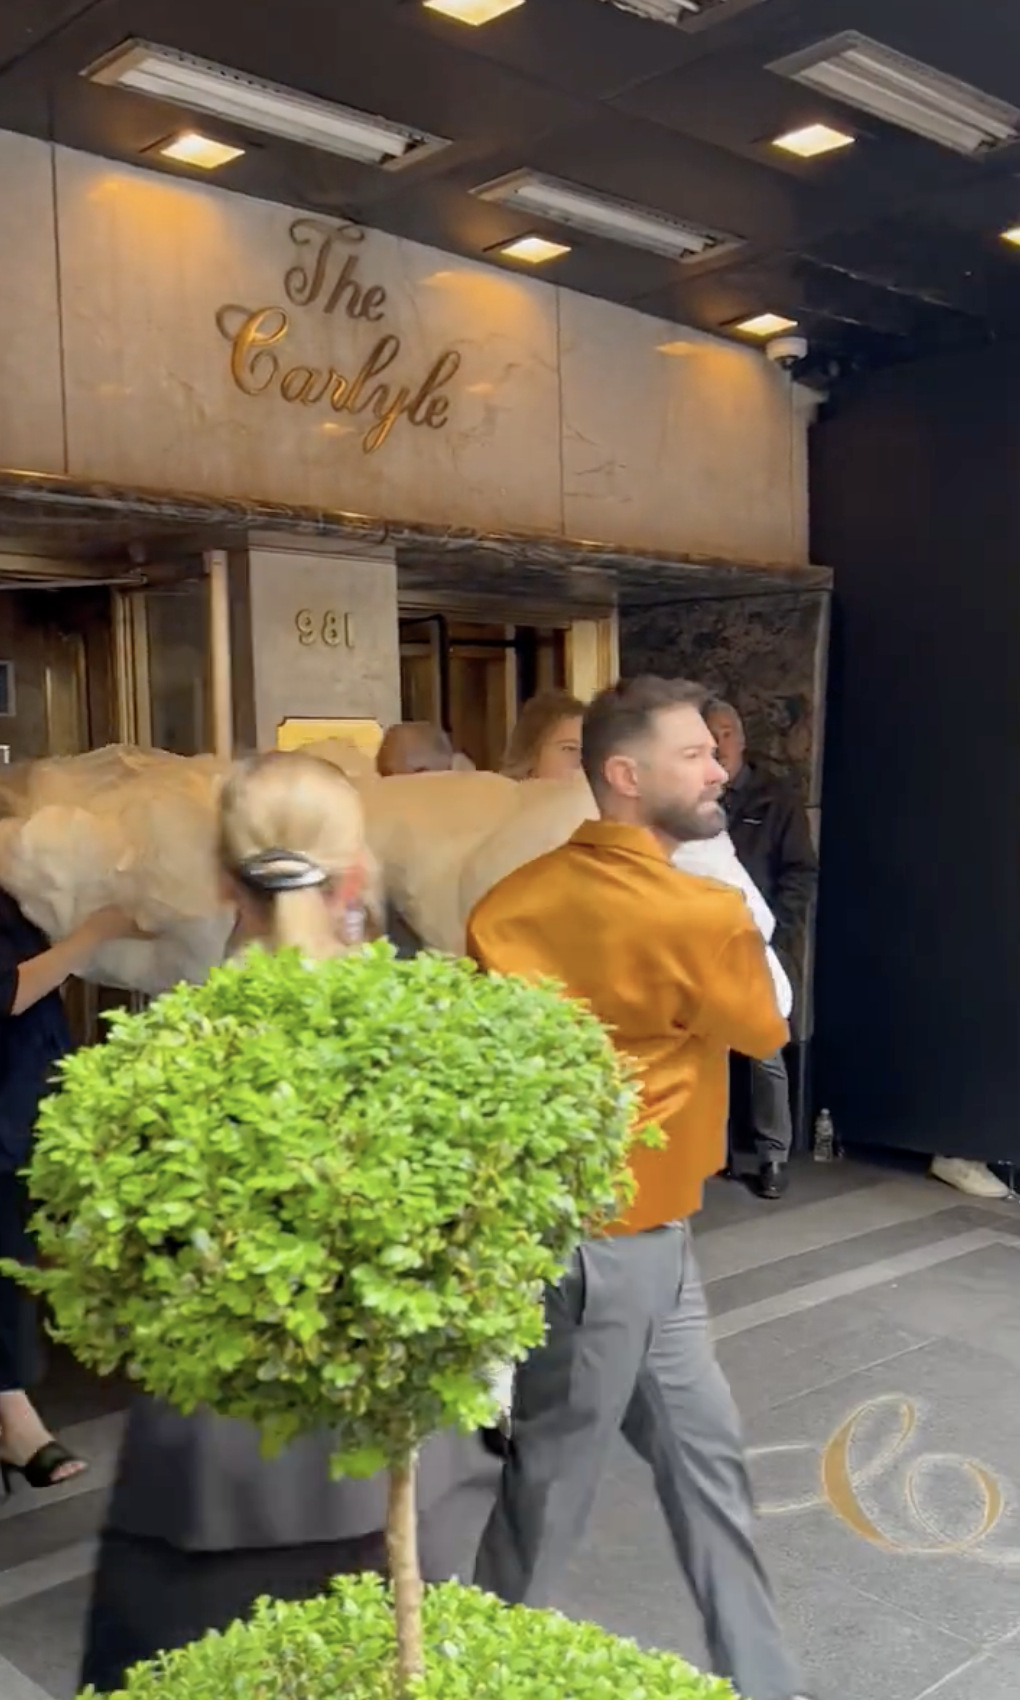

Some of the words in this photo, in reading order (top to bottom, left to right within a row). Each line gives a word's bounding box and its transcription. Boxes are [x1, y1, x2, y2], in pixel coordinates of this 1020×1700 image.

[284, 217, 386, 322] The
[214, 303, 461, 454] Carlyle
[295, 608, 355, 650] 981
